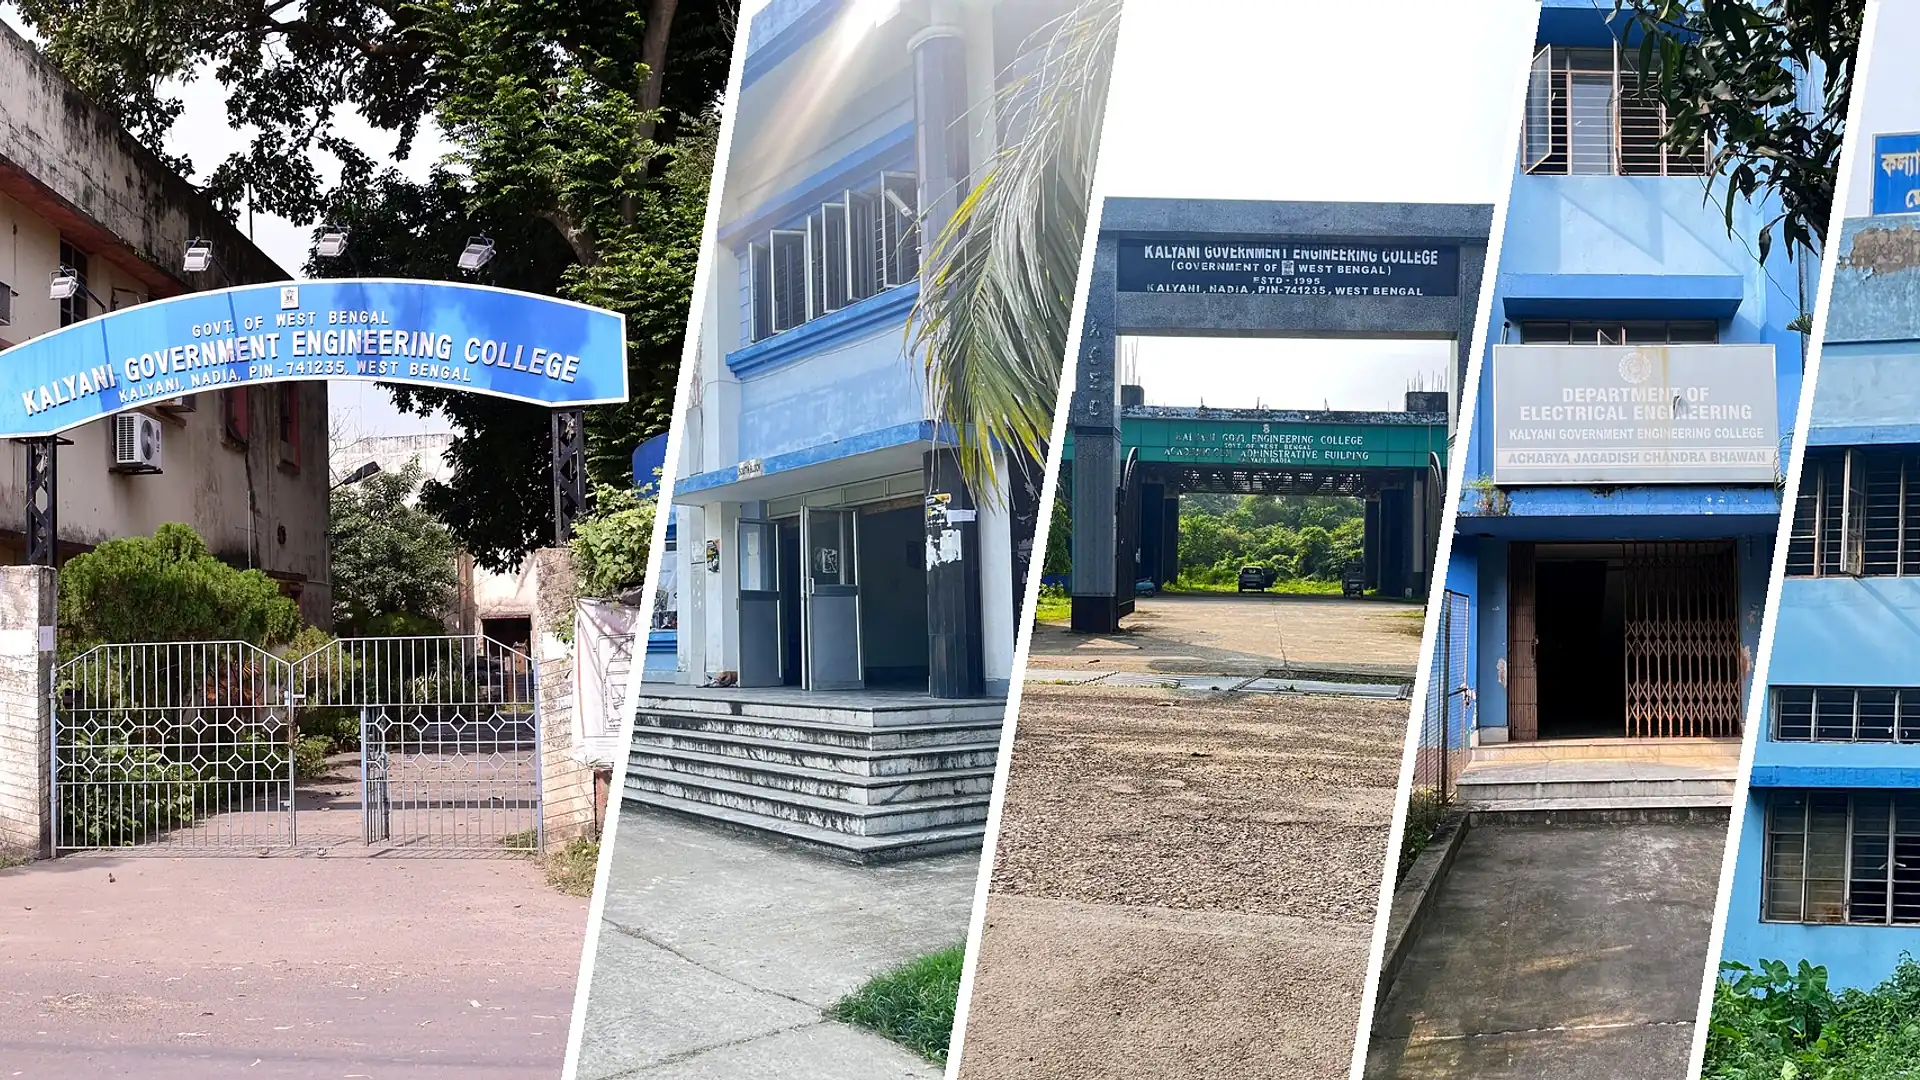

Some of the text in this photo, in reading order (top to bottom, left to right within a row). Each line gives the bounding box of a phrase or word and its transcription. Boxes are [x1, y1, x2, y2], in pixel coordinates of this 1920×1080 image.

[1144, 244, 1438, 265] KALYANI GOVERNMENT ENGINEERING COLLEGE
[1171, 260, 1391, 275] (GOVERNMENT OF WEST BENGAL)
[1253, 276, 1283, 285] ESTD
[1294, 277, 1320, 285] 1995
[1335, 286, 1369, 295] WEST
[1373, 287, 1423, 296] BENGAL
[192, 310, 389, 338] GOVT. OF WEST BENGAL
[21, 329, 580, 417] KALYANI GOVERNMENT ENGINEERING COLLEGE
[118, 378, 185, 403] KALYANI,
[191, 367, 242, 387] NADIA,
[357, 360, 399, 375] WEST
[409, 364, 471, 383] BENGAL
[1562, 387, 1709, 403] DEPARTMENT OF
[1520, 405, 1752, 421] ELECTRICAL ENGINEERING
[1252, 434, 1314, 444] ENGINEERING
[1320, 436, 1363, 445] COLLEGE
[1509, 427, 1764, 440] KALYANI GOVERNMENT ENGINEERING COLLEGE
[1240, 449, 1318, 459] ADMINISTRATIVE
[1324, 451, 1369, 460] BUILDING
[1508, 452, 1766, 465] ACHARYA JAGADISH CHANDRA BHAWAN
